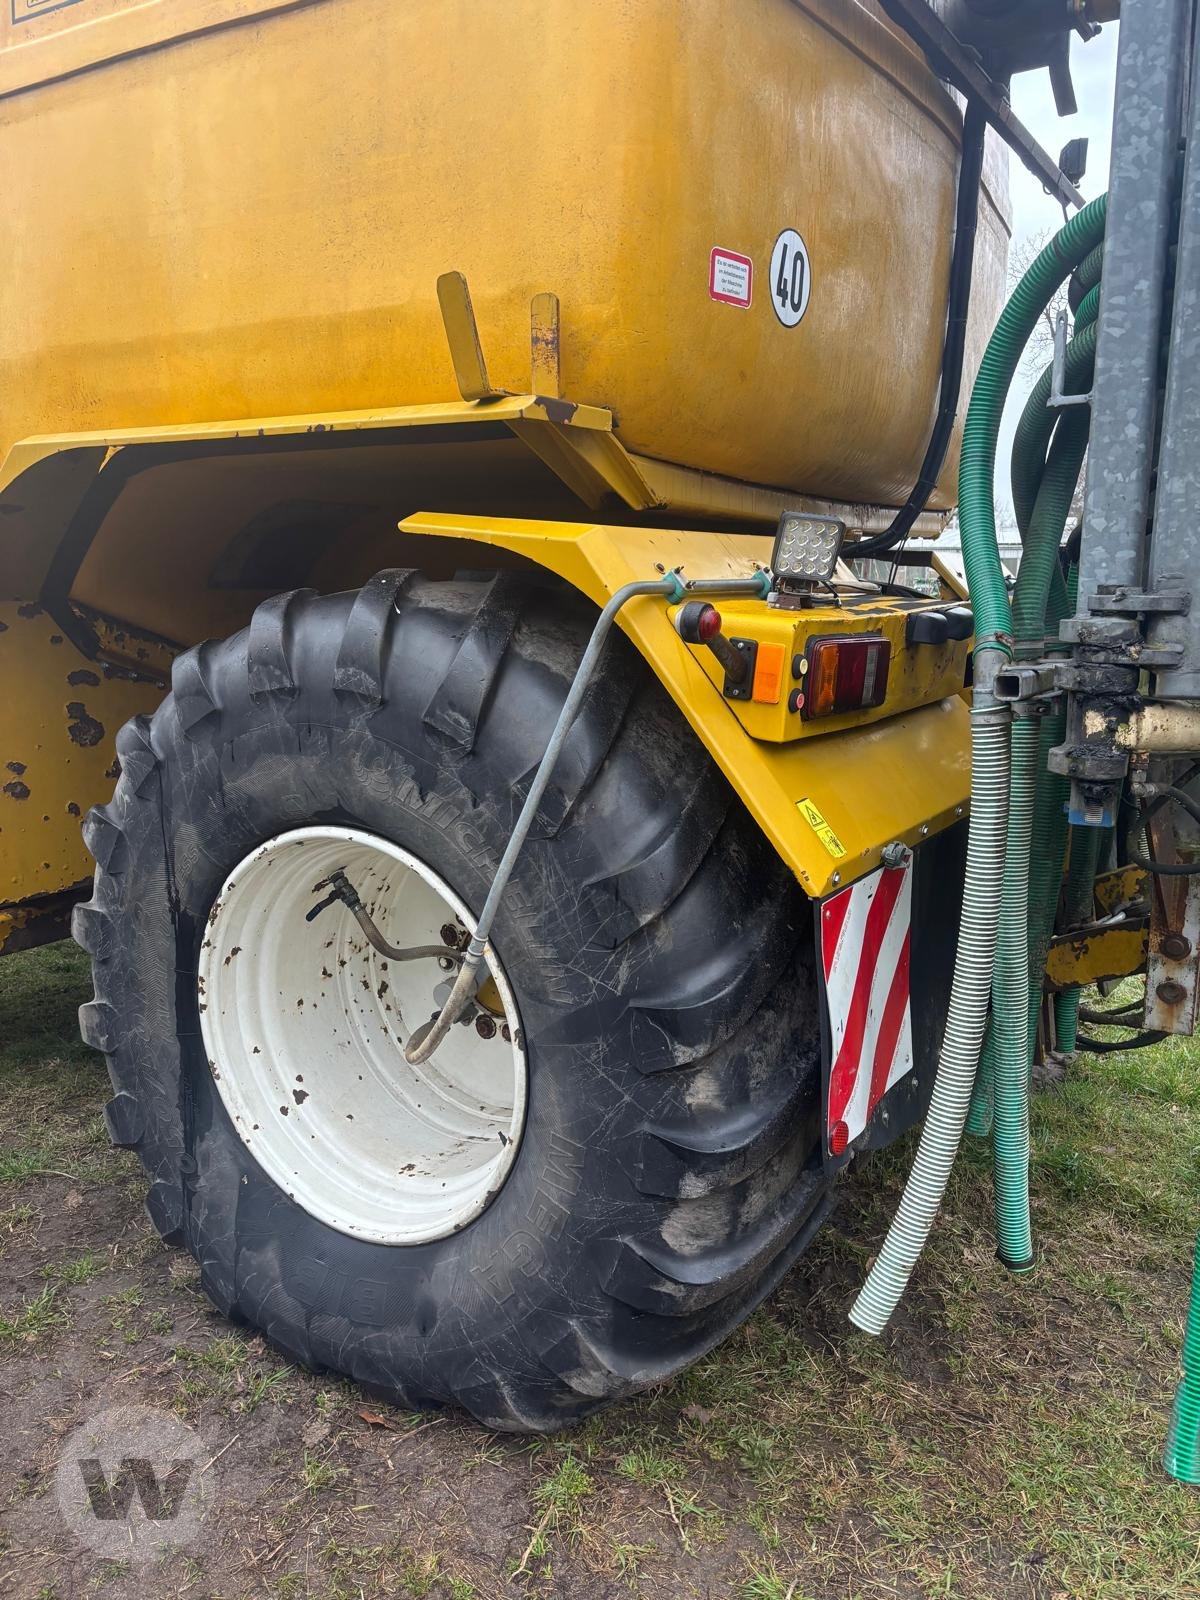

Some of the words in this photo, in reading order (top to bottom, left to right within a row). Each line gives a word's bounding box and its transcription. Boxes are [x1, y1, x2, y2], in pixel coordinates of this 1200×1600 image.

[776, 242, 805, 313] 40
[397, 776, 574, 1005] MICHELIN
[470, 1131, 586, 1306] MEGA
